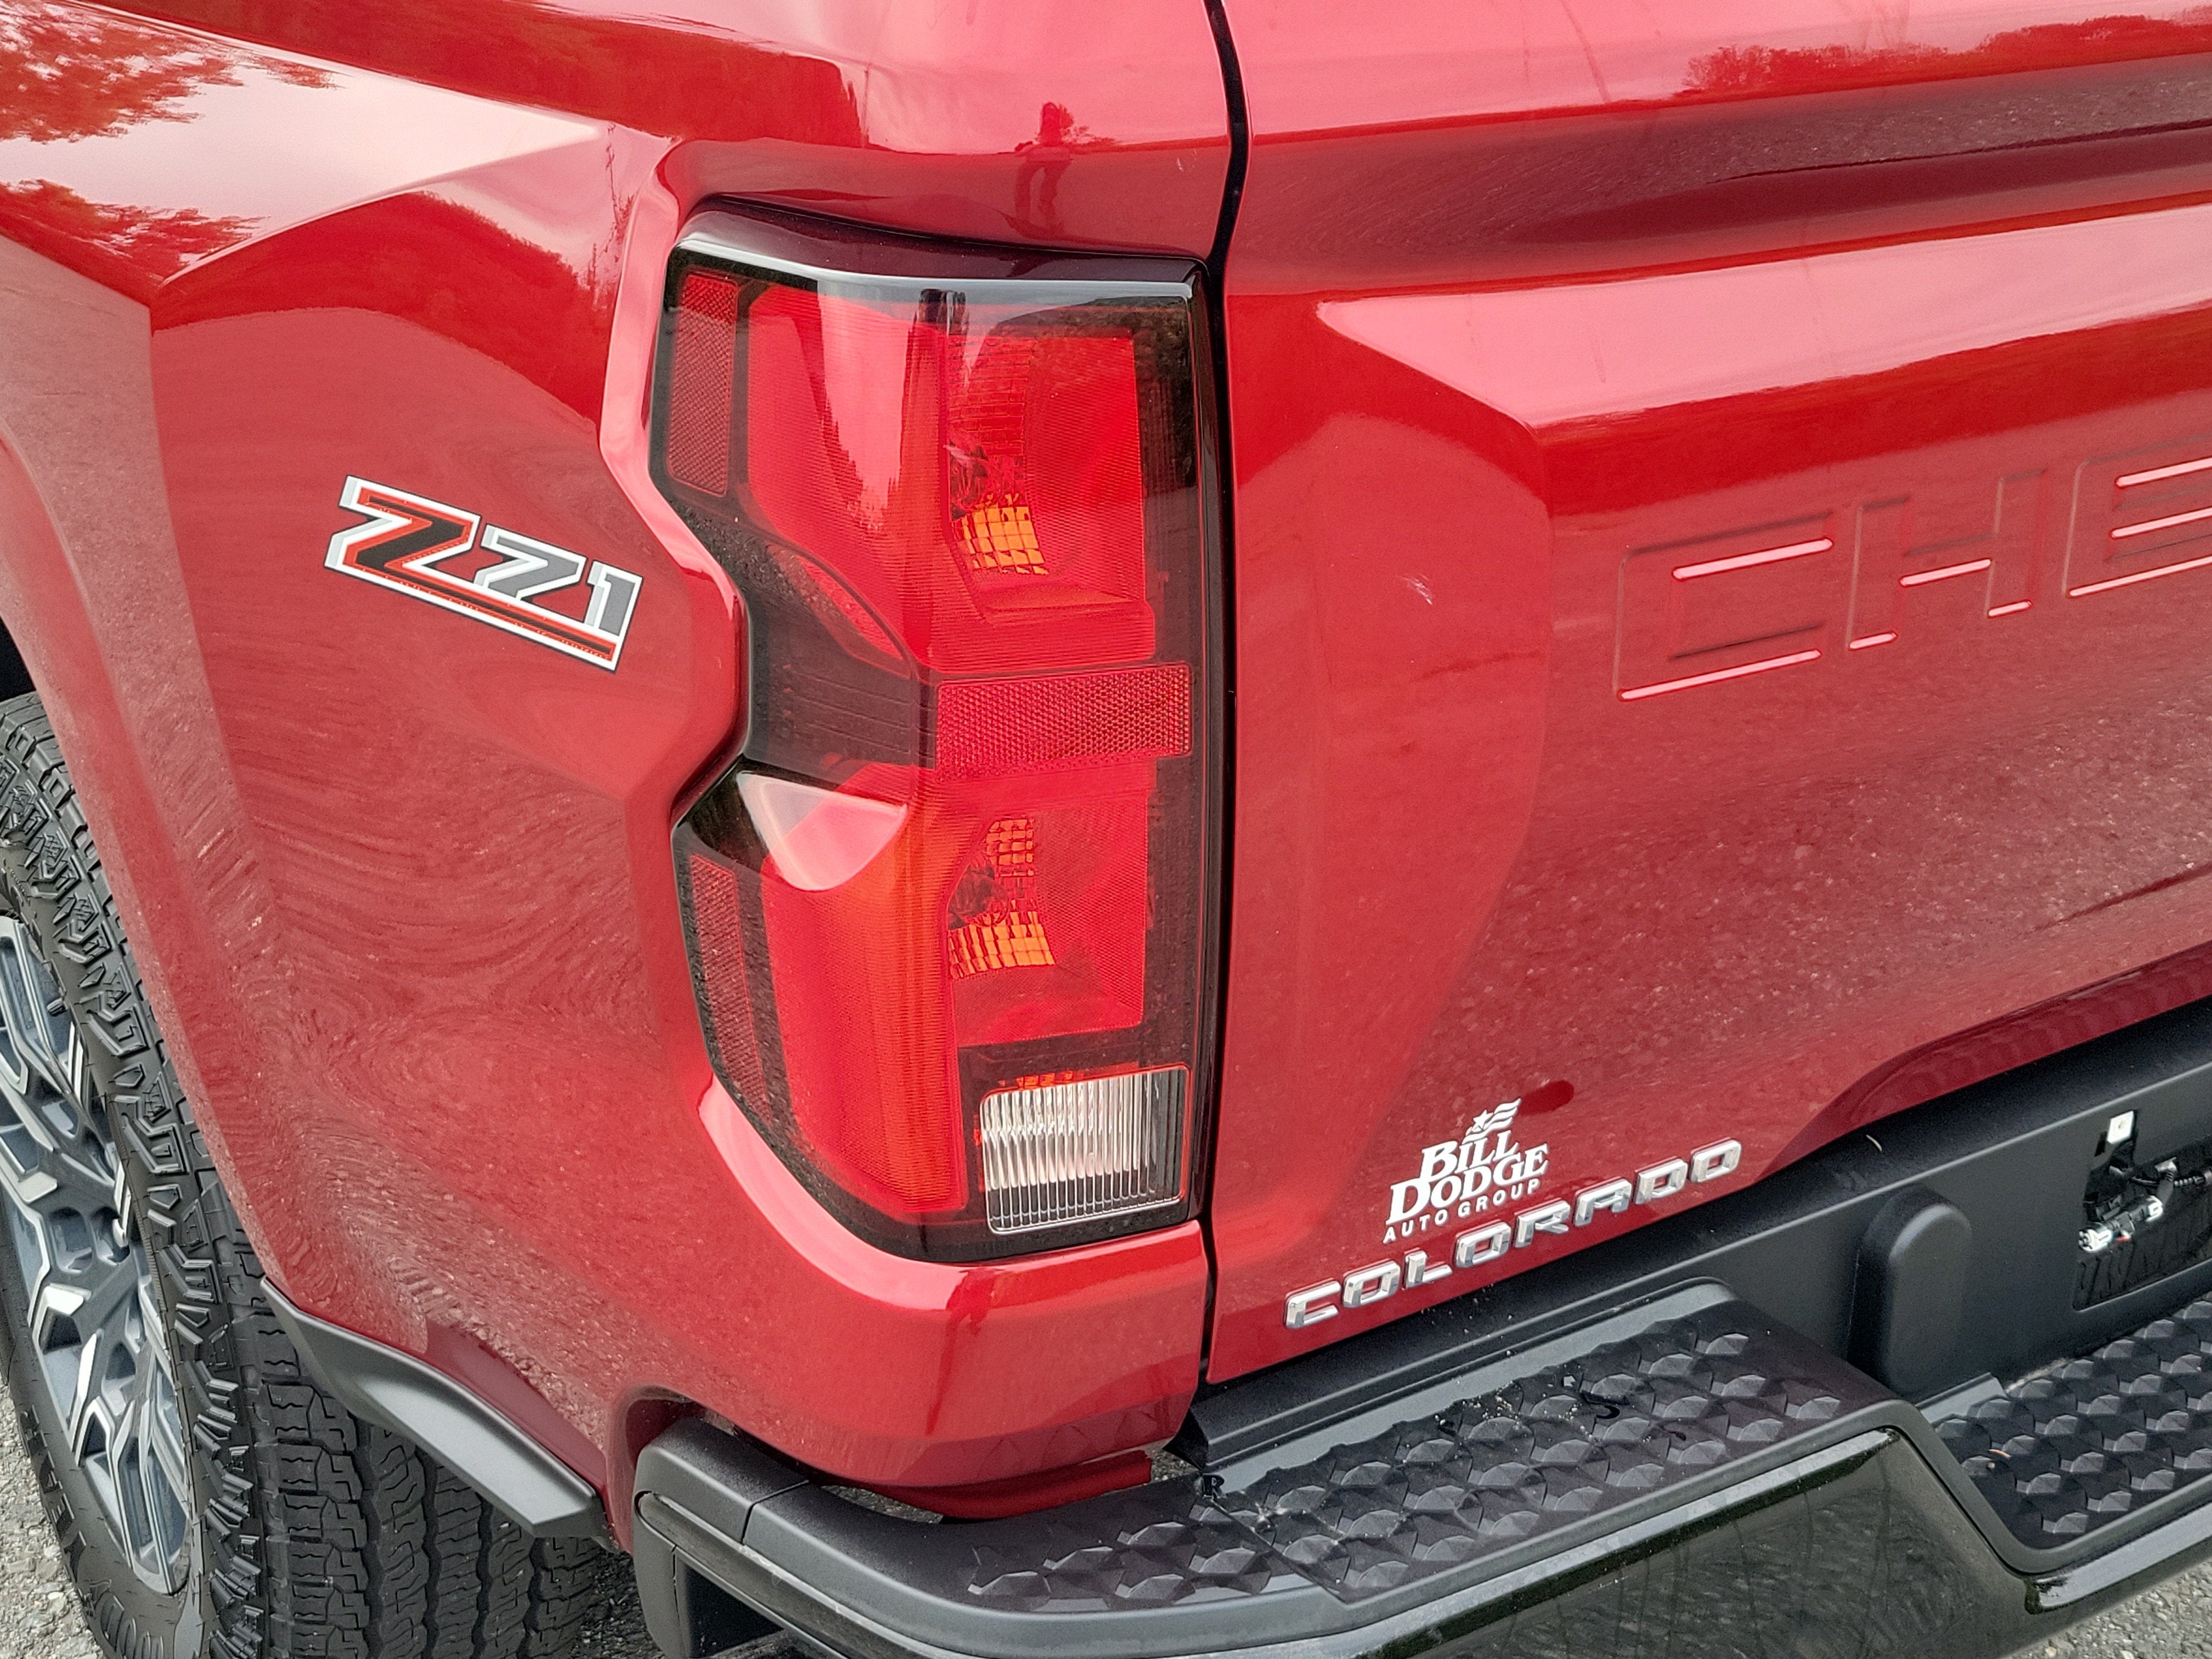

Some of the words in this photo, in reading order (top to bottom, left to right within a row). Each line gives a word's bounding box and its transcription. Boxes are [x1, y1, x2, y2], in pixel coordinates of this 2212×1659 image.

[324, 475, 644, 673] Z71
[1385, 1143, 1549, 1226] DODGE
[1420, 1130, 1519, 1183] BILL
[1283, 1137, 1743, 1330] COLORADO
[1382, 1209, 1448, 1244] AUTO
[1457, 1178, 1541, 1218] GROUP
